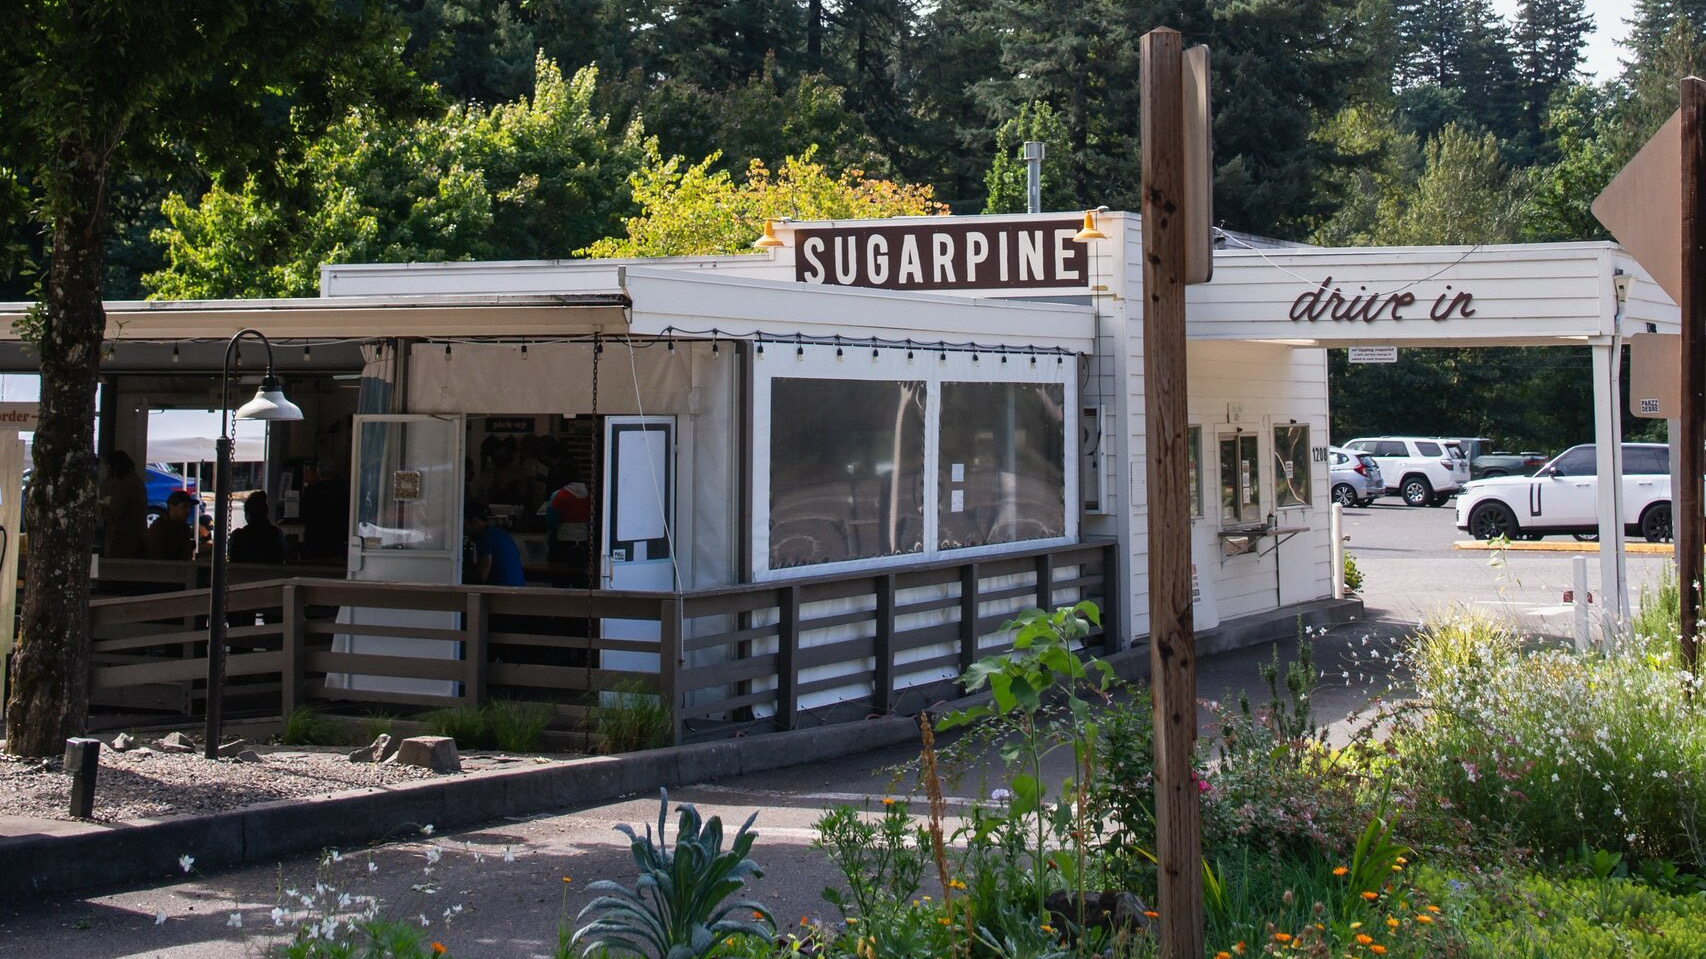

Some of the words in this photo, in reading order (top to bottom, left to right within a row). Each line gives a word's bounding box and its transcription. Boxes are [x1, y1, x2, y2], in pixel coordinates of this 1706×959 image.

[803, 229, 1080, 285] SUGARPINE
[1289, 276, 1415, 323] drive
[1430, 285, 1475, 321] in
[0, 410, 30, 422] rder
